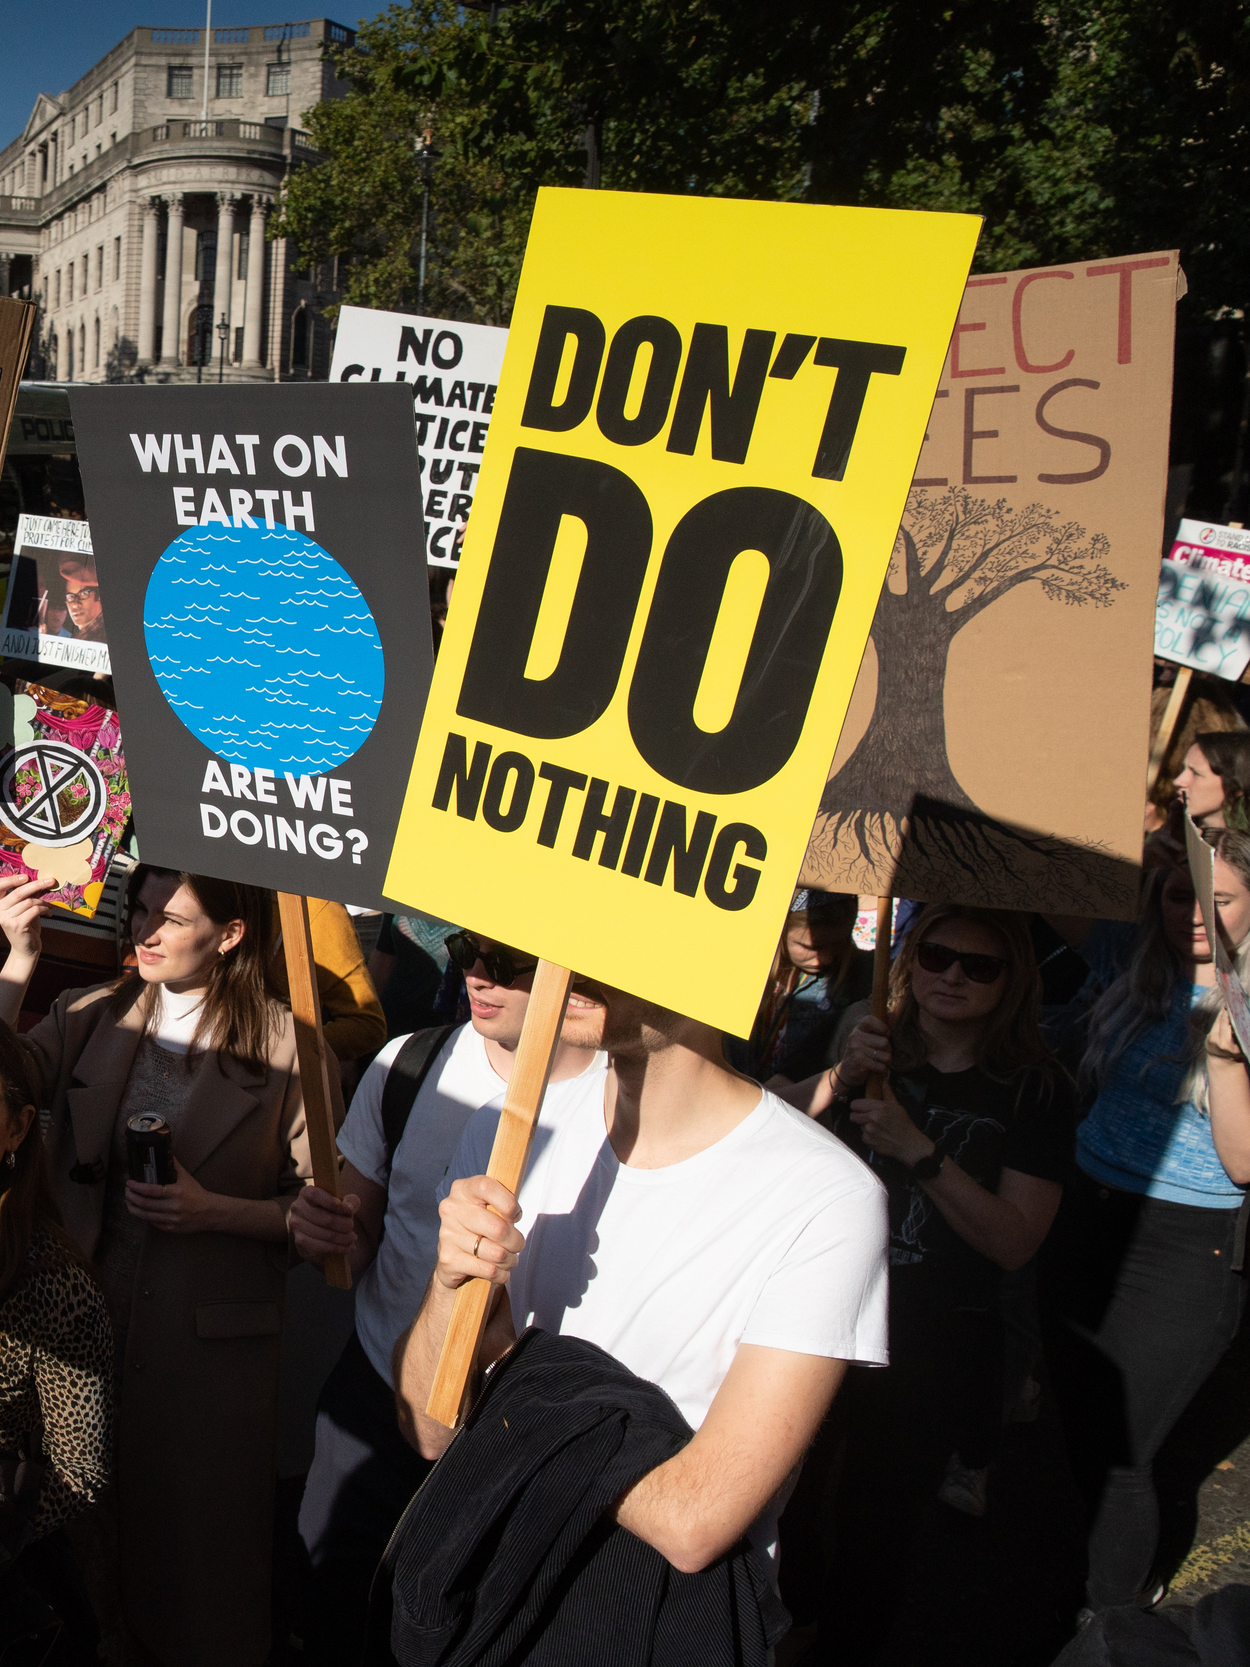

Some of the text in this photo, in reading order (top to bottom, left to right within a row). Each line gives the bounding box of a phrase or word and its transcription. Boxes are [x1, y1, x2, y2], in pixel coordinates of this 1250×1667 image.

[397, 326, 463, 370] NO
[520, 304, 908, 482] DON'T
[130, 433, 349, 478] WHAT ON
[24, 517, 42, 532] JUST
[43, 518, 62, 534] CAME
[62, 520, 80, 538] HERE
[173, 487, 316, 532] EARTH
[23, 532, 61, 547] PROTEST
[60, 537, 76, 549] FOR
[1173, 546, 1250, 580] Climate
[456, 446, 844, 795] DO
[1175, 607, 1224, 634] NOT
[2, 634, 23, 653] AND
[25, 636, 30, 655] I
[31, 638, 55, 656] JUST
[55, 642, 97, 667] FINISHED
[201, 760, 354, 817] ARE WE
[200, 803, 368, 865] DOING?
[431, 732, 768, 911] NOTHING
